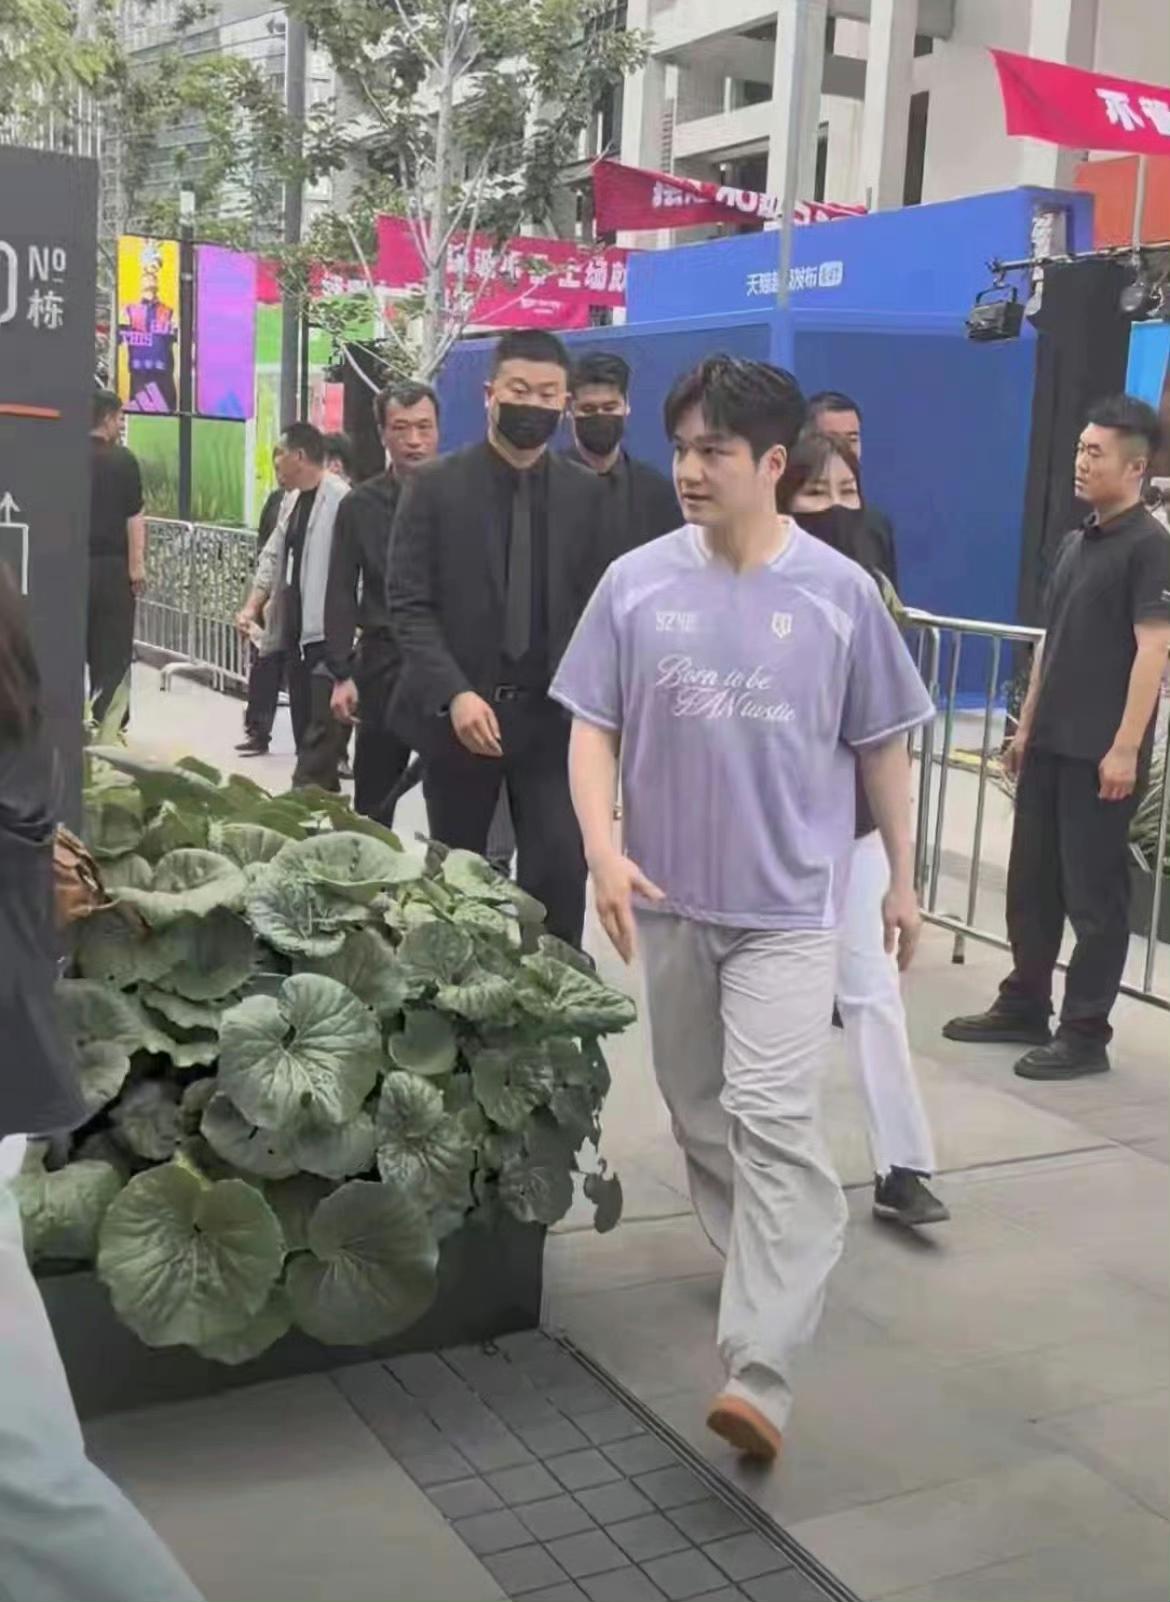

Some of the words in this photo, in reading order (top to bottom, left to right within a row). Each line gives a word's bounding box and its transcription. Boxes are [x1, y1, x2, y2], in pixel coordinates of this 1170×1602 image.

[27, 288, 64, 329] 栋
[656, 653, 718, 688] Born
[724, 669, 744, 686] to
[746, 665, 770, 689] be
